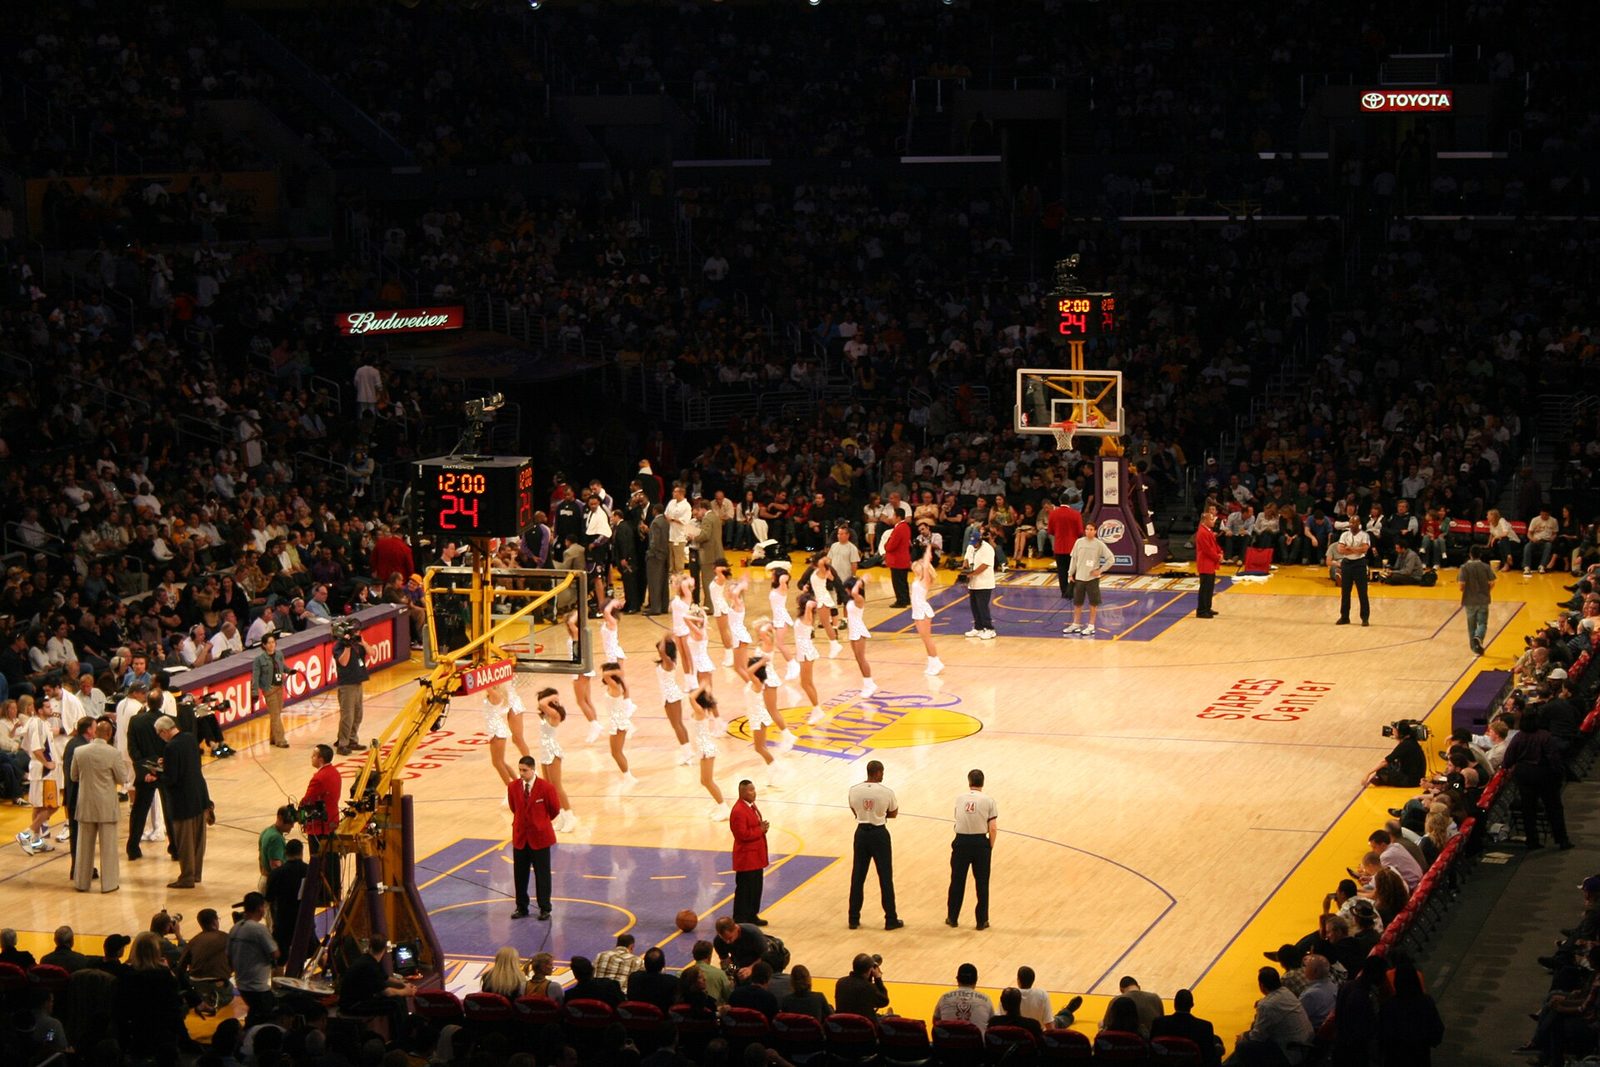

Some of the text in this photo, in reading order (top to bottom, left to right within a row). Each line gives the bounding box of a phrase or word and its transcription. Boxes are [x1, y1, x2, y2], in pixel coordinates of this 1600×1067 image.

[1386, 94, 1450, 107] TOYOTA
[1059, 299, 1090, 313] 12:00
[347, 311, 449, 334] Budweiser
[1059, 313, 1086, 335] 24
[438, 473, 486, 494] 12:00
[440, 494, 478, 530] 24
[476, 663, 512, 688] AAA.com
[1196, 678, 1285, 721] STAPLES
[1251, 680, 1336, 722] Center
[965, 802, 976, 813] 24
